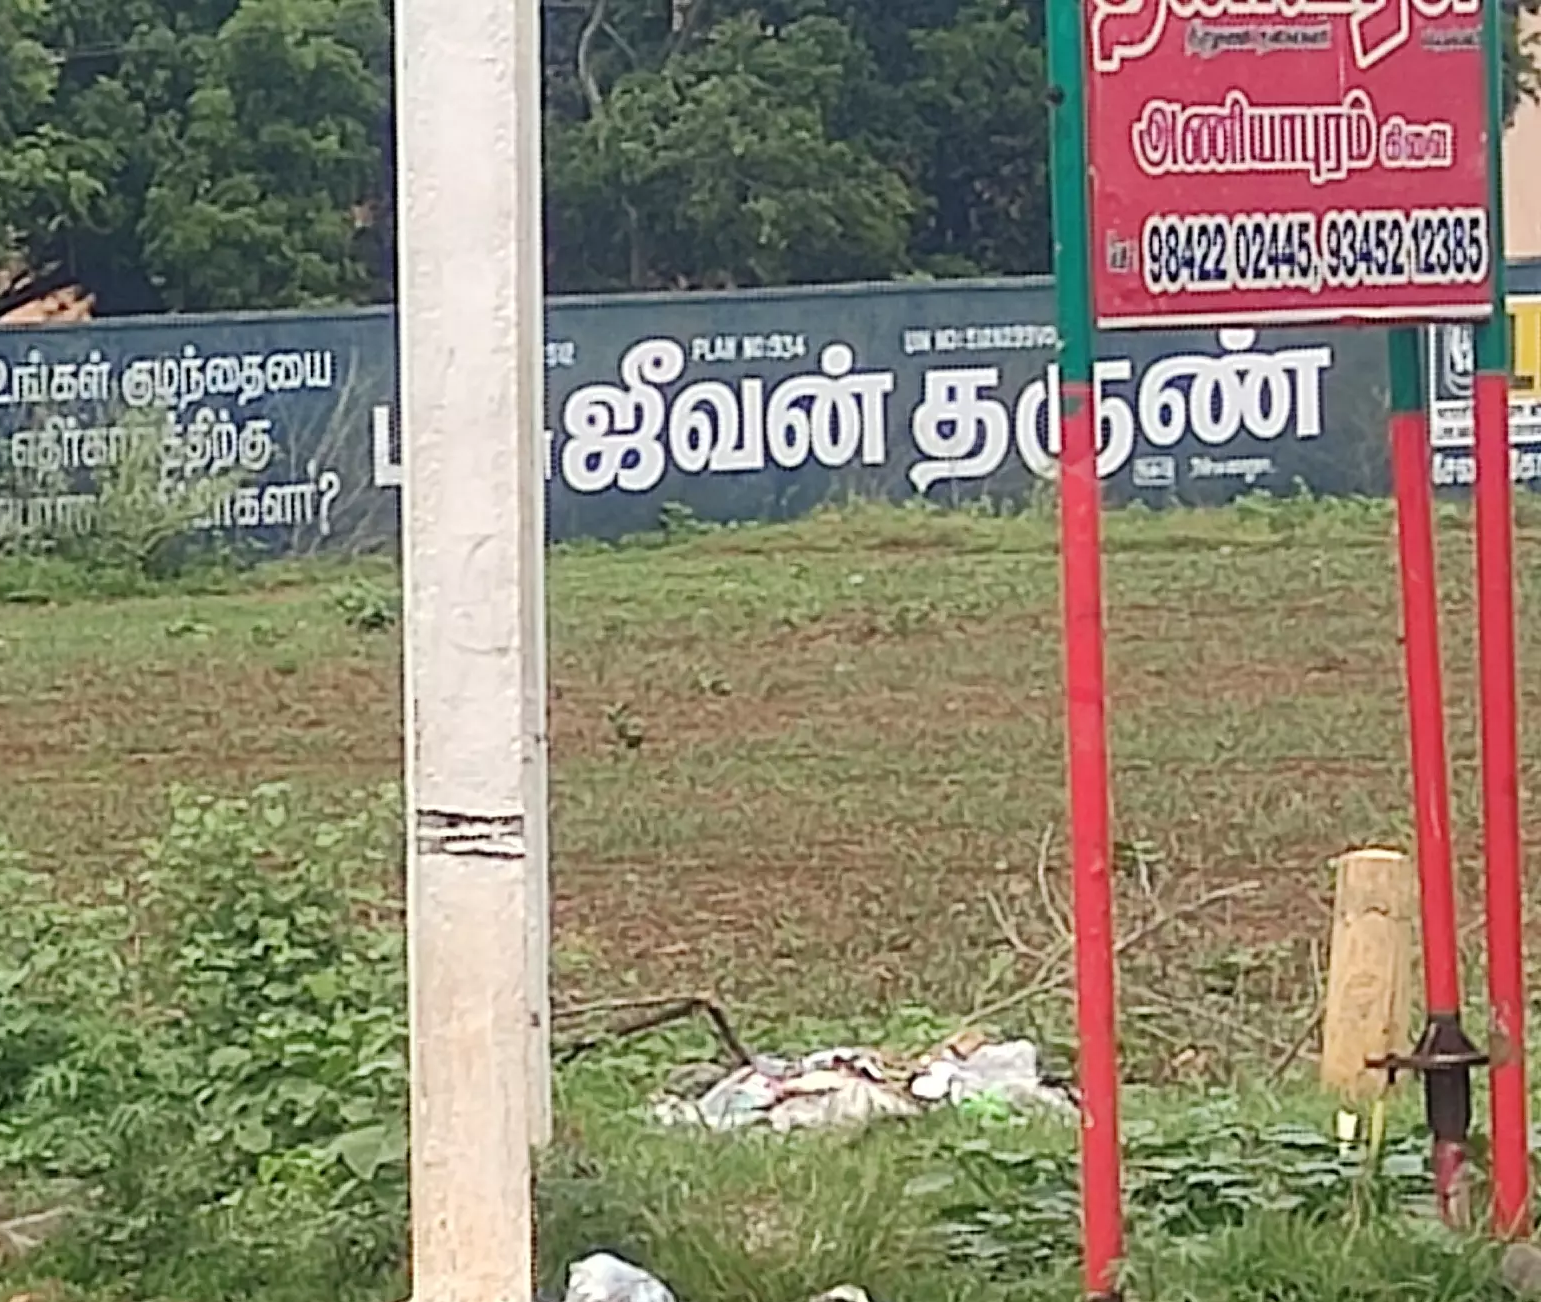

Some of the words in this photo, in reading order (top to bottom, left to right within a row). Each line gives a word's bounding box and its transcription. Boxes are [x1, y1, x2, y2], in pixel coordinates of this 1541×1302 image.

[1145, 214, 1230, 290] 98422
[1323, 211, 1405, 284] 93452
[1409, 208, 1489, 283] 12385
[563, 338, 894, 493] ஜீவன்
[908, 328, 1331, 493] தருண்
